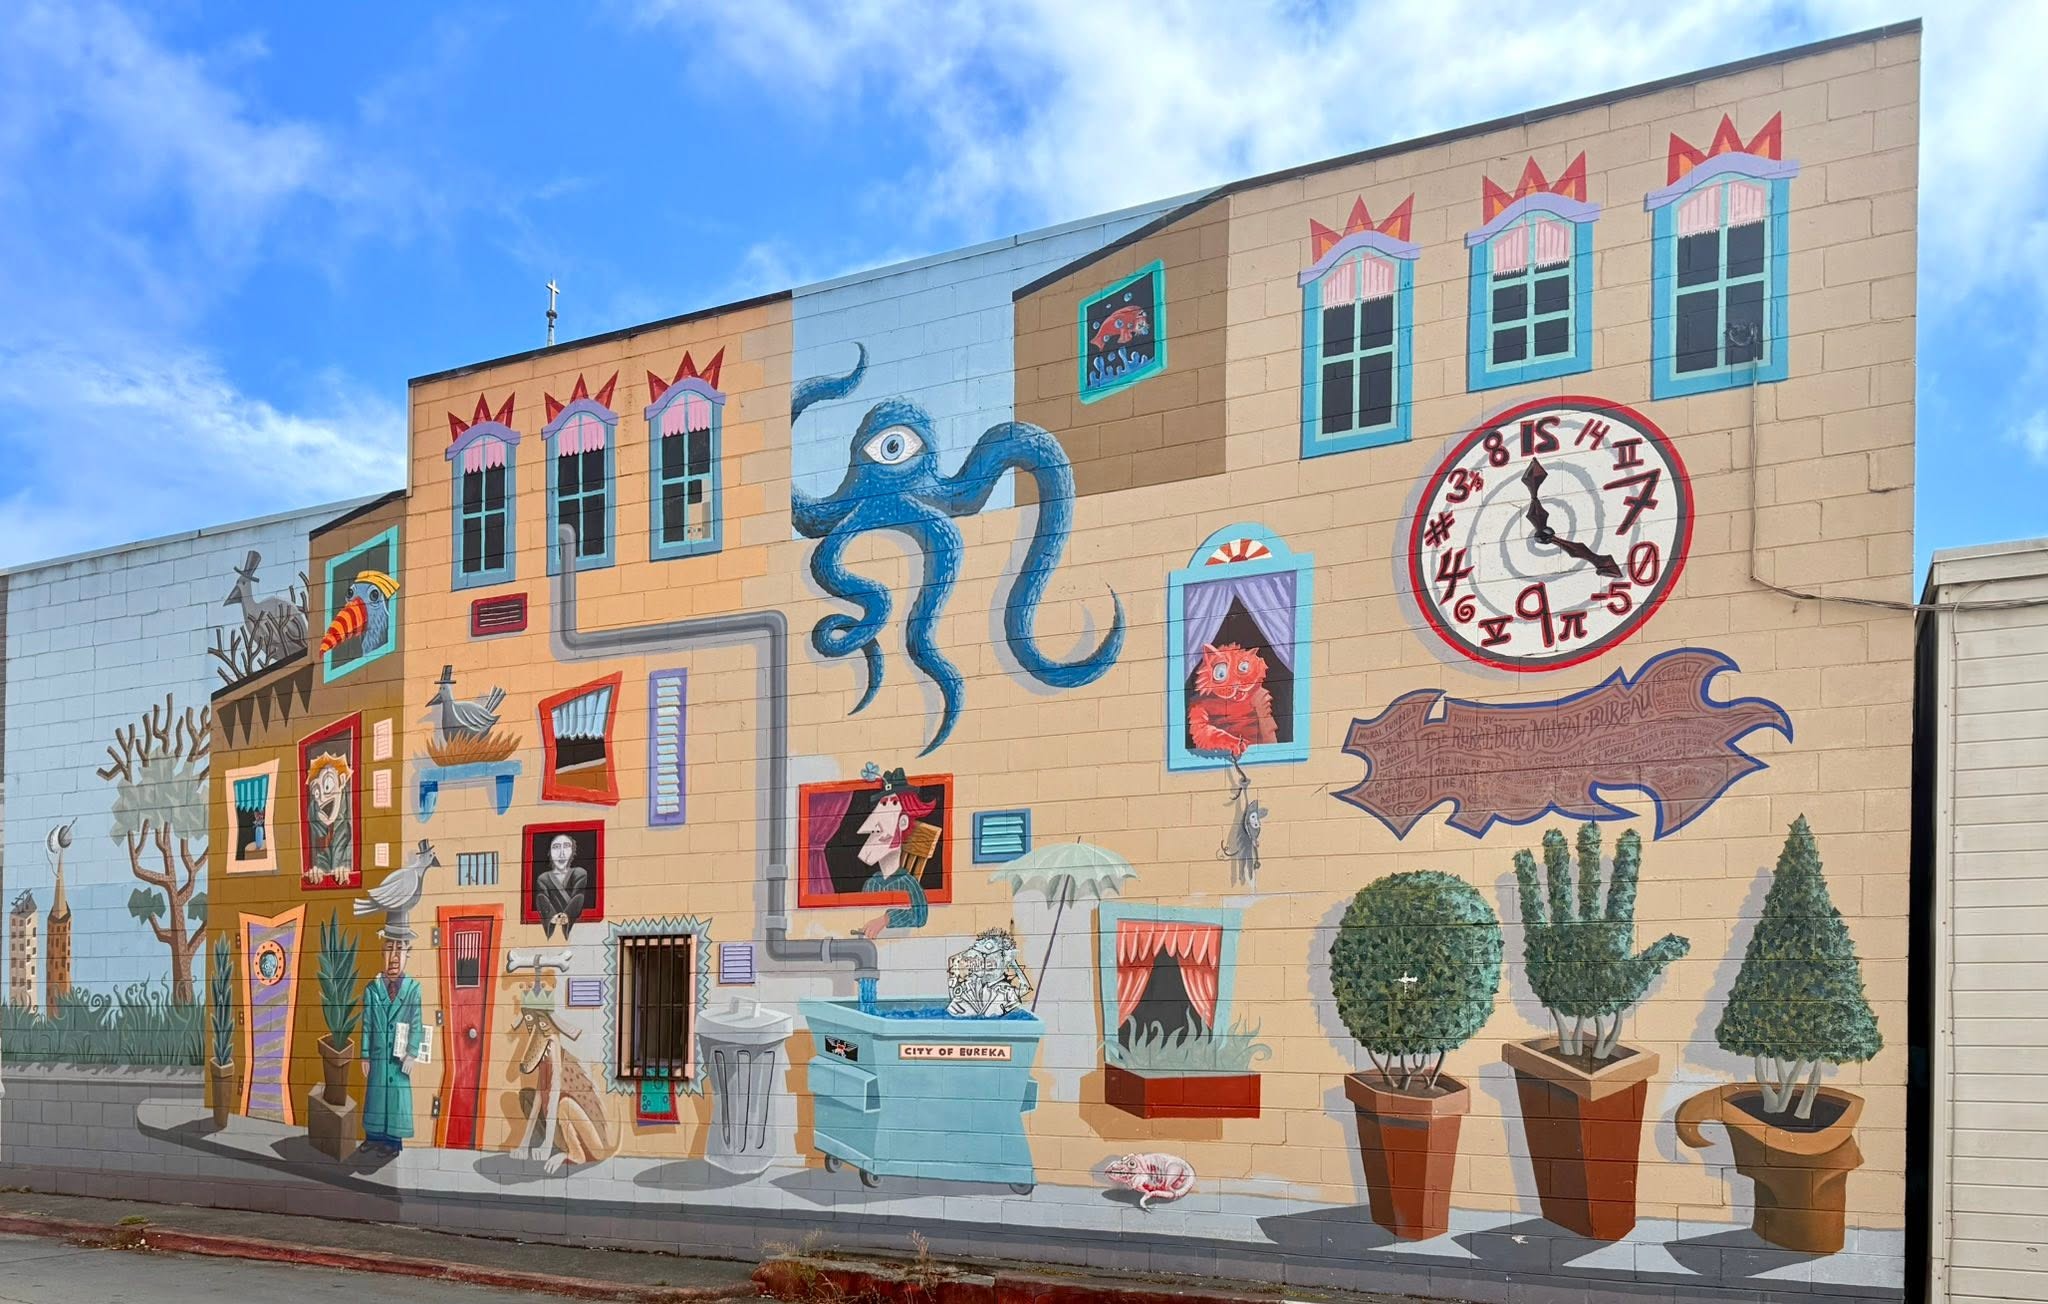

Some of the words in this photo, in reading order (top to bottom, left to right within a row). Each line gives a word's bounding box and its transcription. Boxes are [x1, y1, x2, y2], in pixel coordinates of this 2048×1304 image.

[1482, 430, 1511, 468] 8
[1603, 468, 1662, 536] 7
[1434, 546, 1475, 606] 4
[1453, 594, 1477, 624] 6
[1515, 581, 1555, 648] 9
[1483, 714, 1495, 725] BY
[1358, 728, 1384, 741] MURAL
[1422, 731, 1448, 750] THE
[1380, 747, 1414, 768] COUNCIL
[1436, 777, 1456, 790] THE
[904, 1047, 933, 1056] CITY
[938, 1048, 954, 1056] OF
[959, 1048, 1006, 1058] EUREKA
